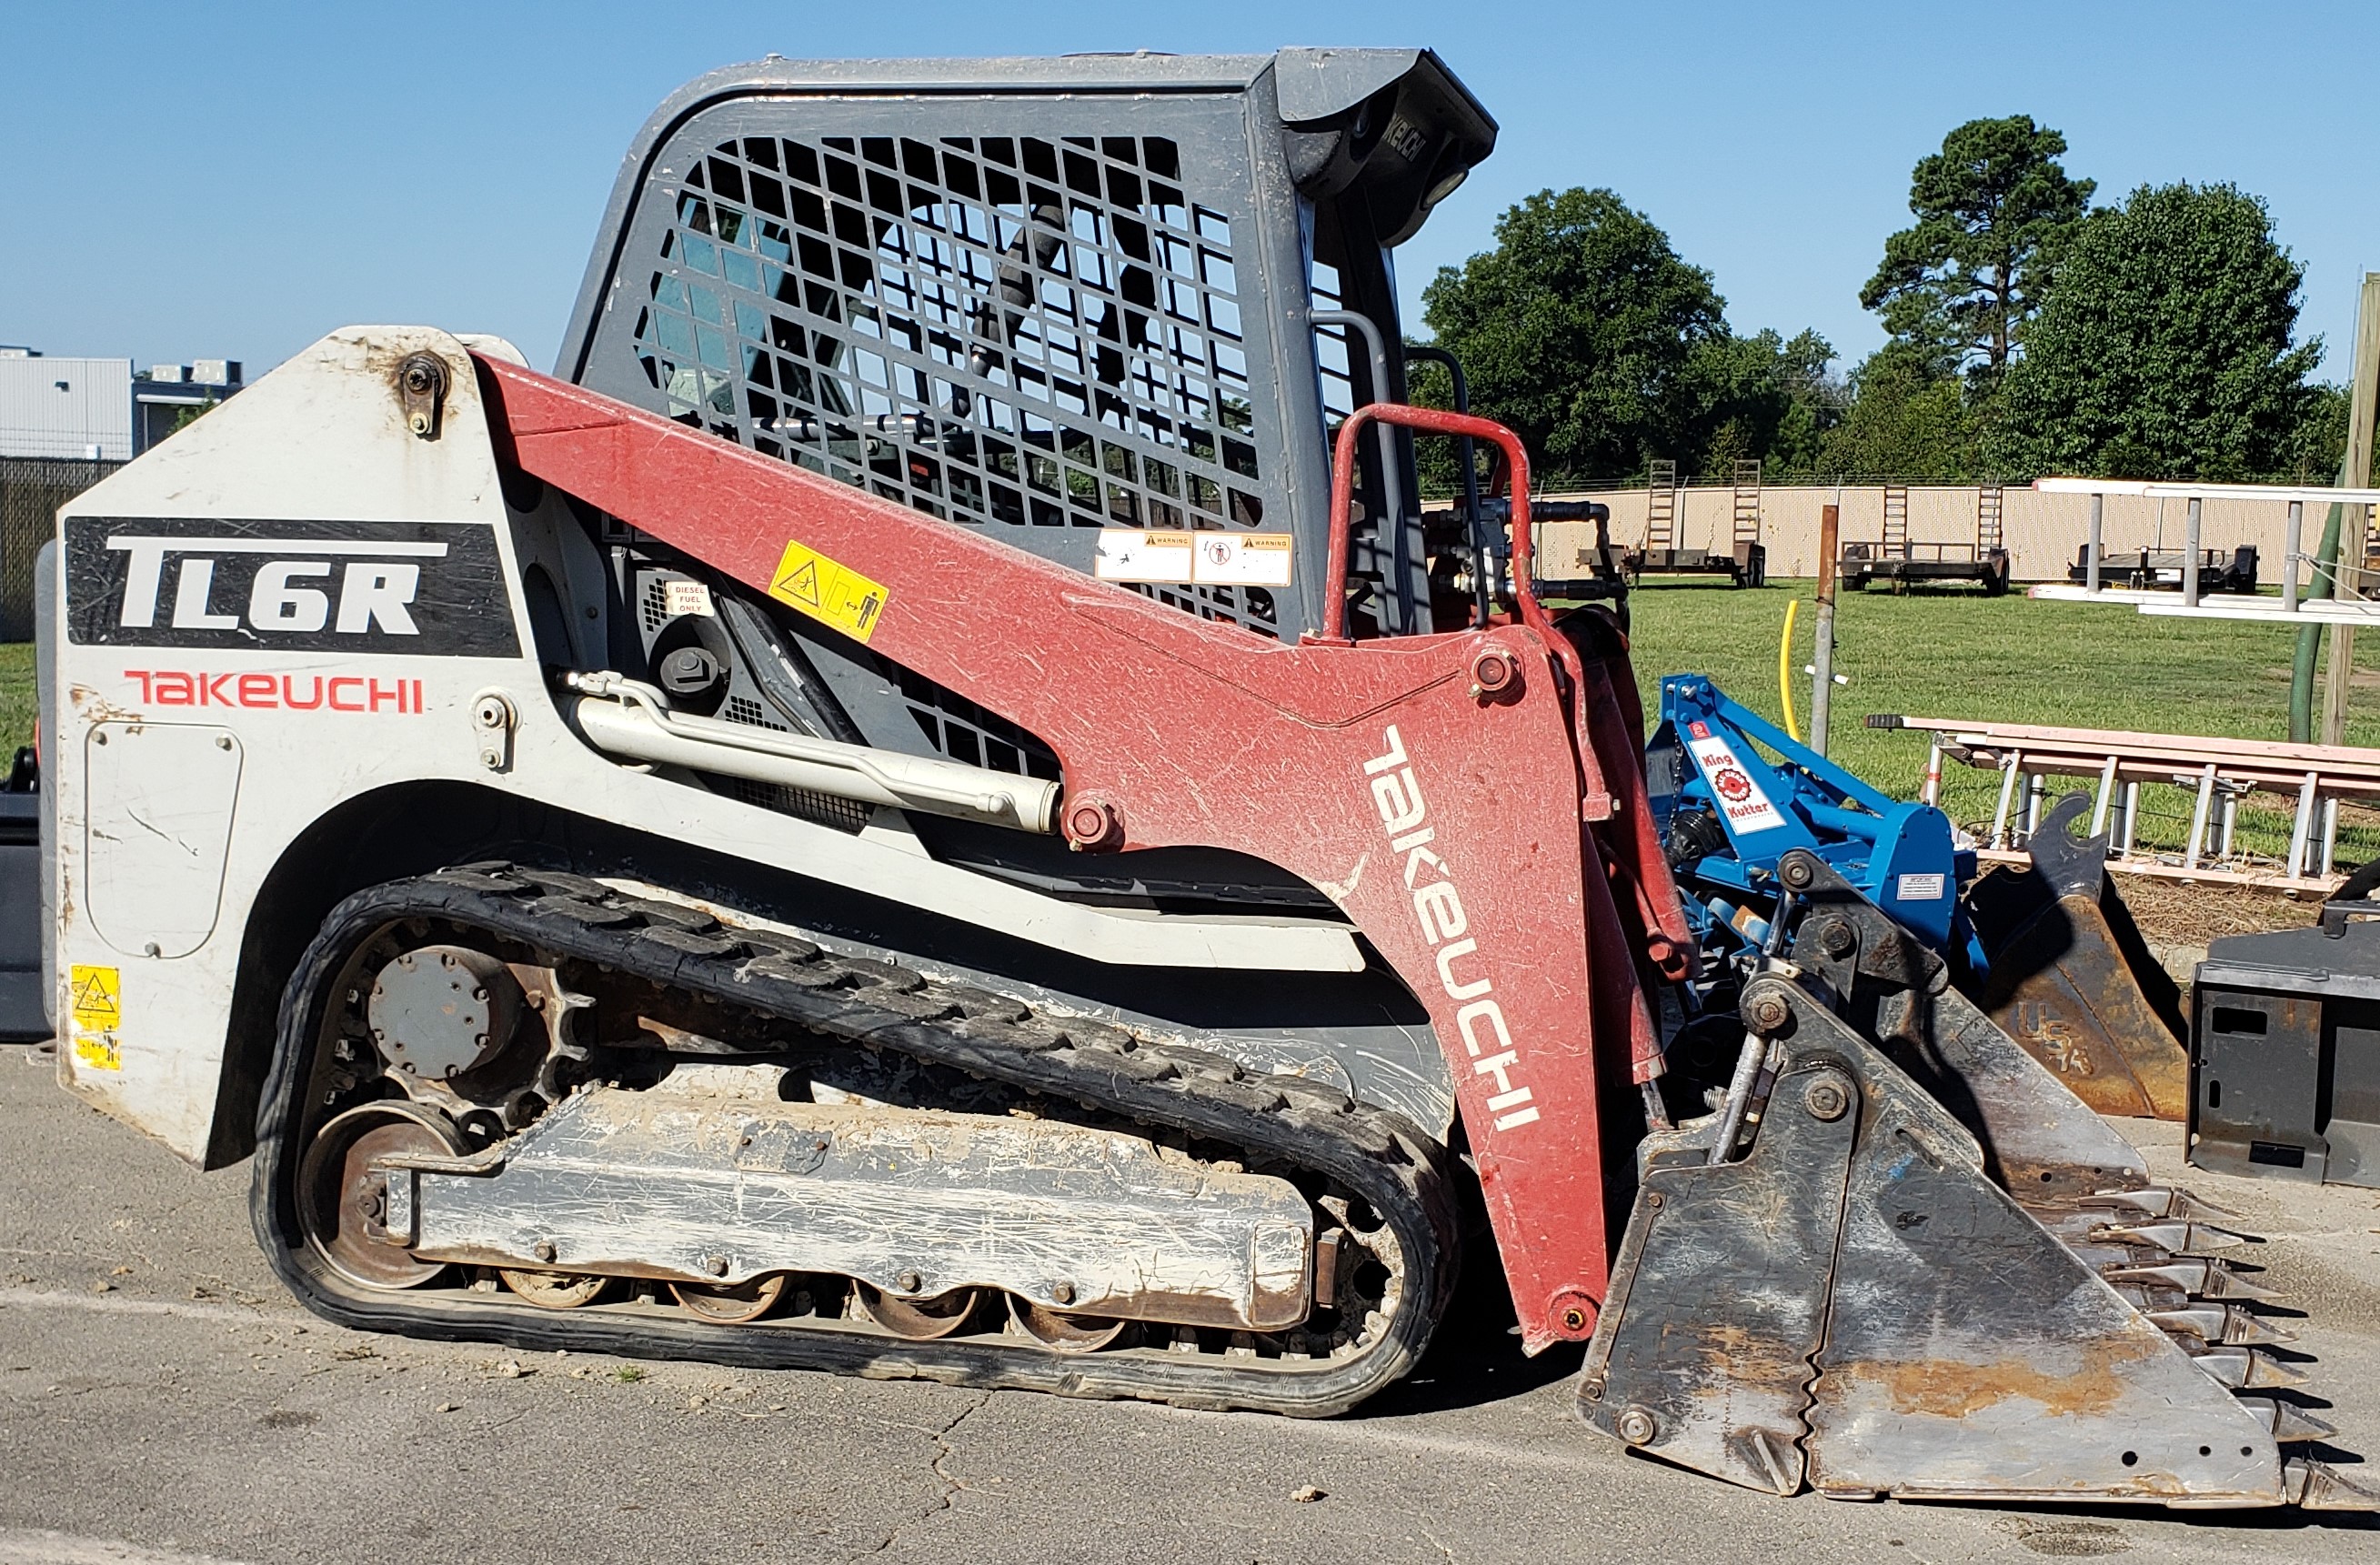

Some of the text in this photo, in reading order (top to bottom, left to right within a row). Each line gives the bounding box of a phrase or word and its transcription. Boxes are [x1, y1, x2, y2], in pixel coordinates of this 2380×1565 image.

[106, 535, 448, 636] TL6R
[1702, 753, 1733, 767] King
[1727, 803, 1769, 818] Kutter
[2017, 1001, 2094, 1075] USA
